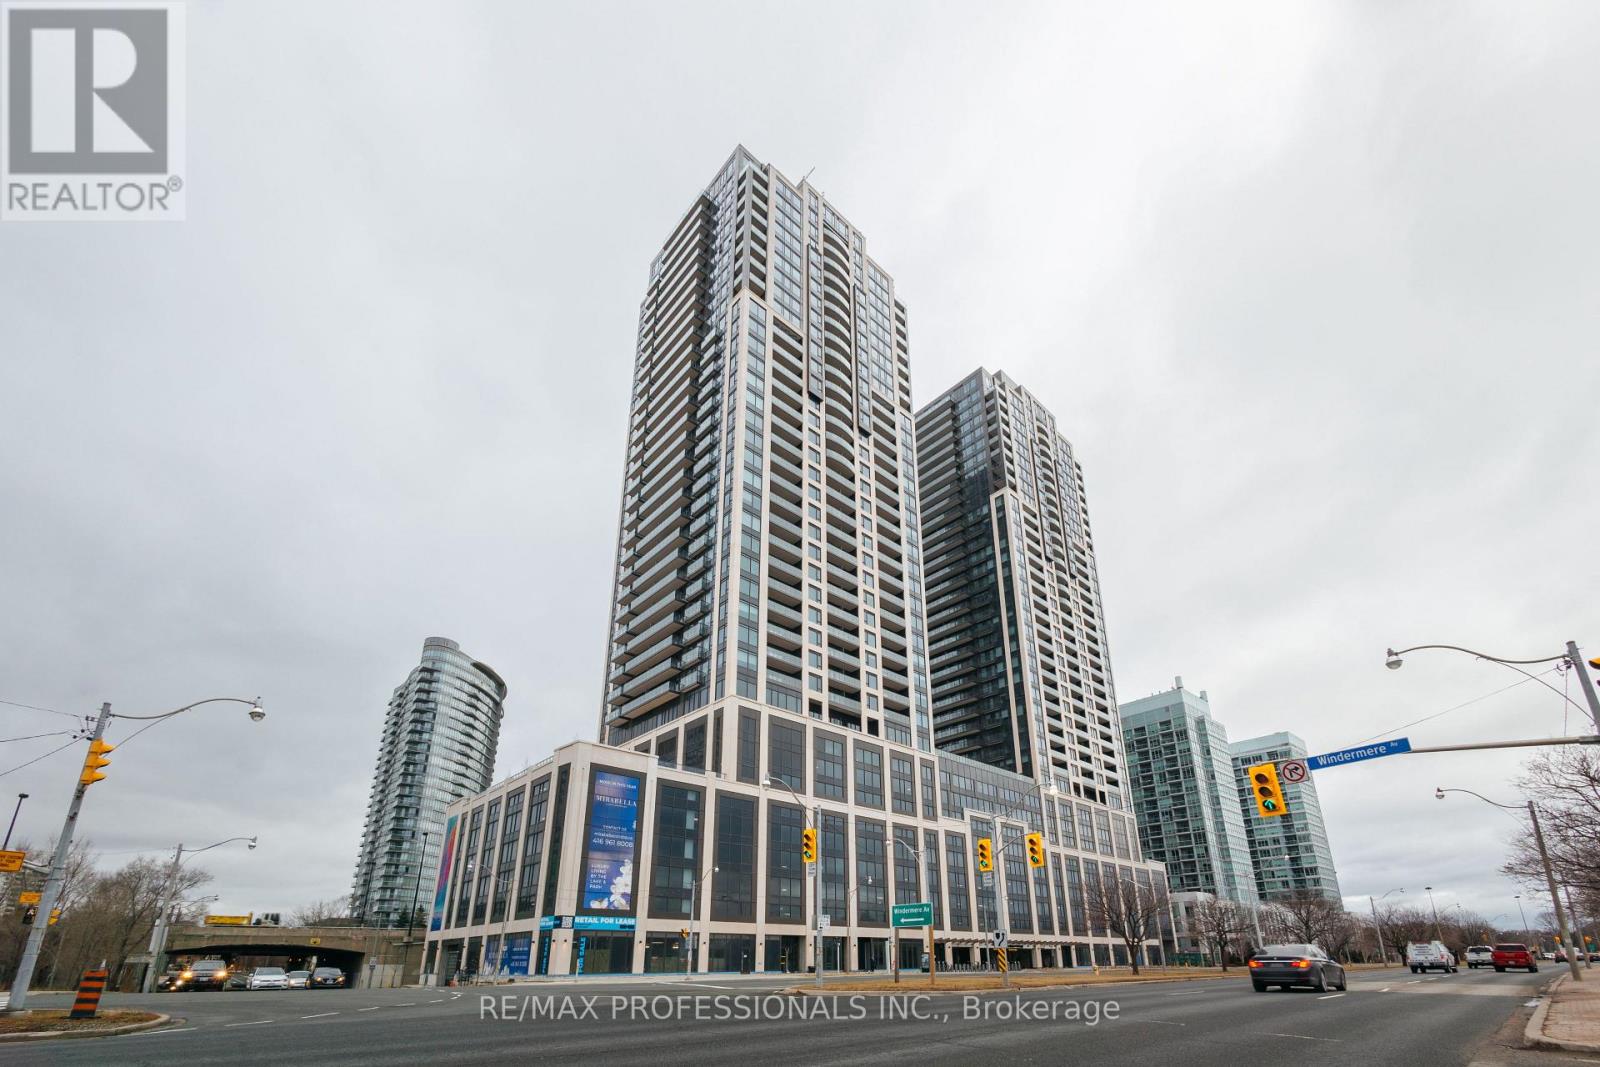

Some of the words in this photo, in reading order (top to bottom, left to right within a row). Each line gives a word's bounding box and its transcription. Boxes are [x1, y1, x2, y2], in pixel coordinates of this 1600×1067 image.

[1317, 745, 1387, 766] Windermere
[596, 795, 637, 807] MIRABELLA
[574, 916, 599, 924] RETAIL
[600, 916, 614, 924] FOR
[615, 917, 636, 925] LEASE
